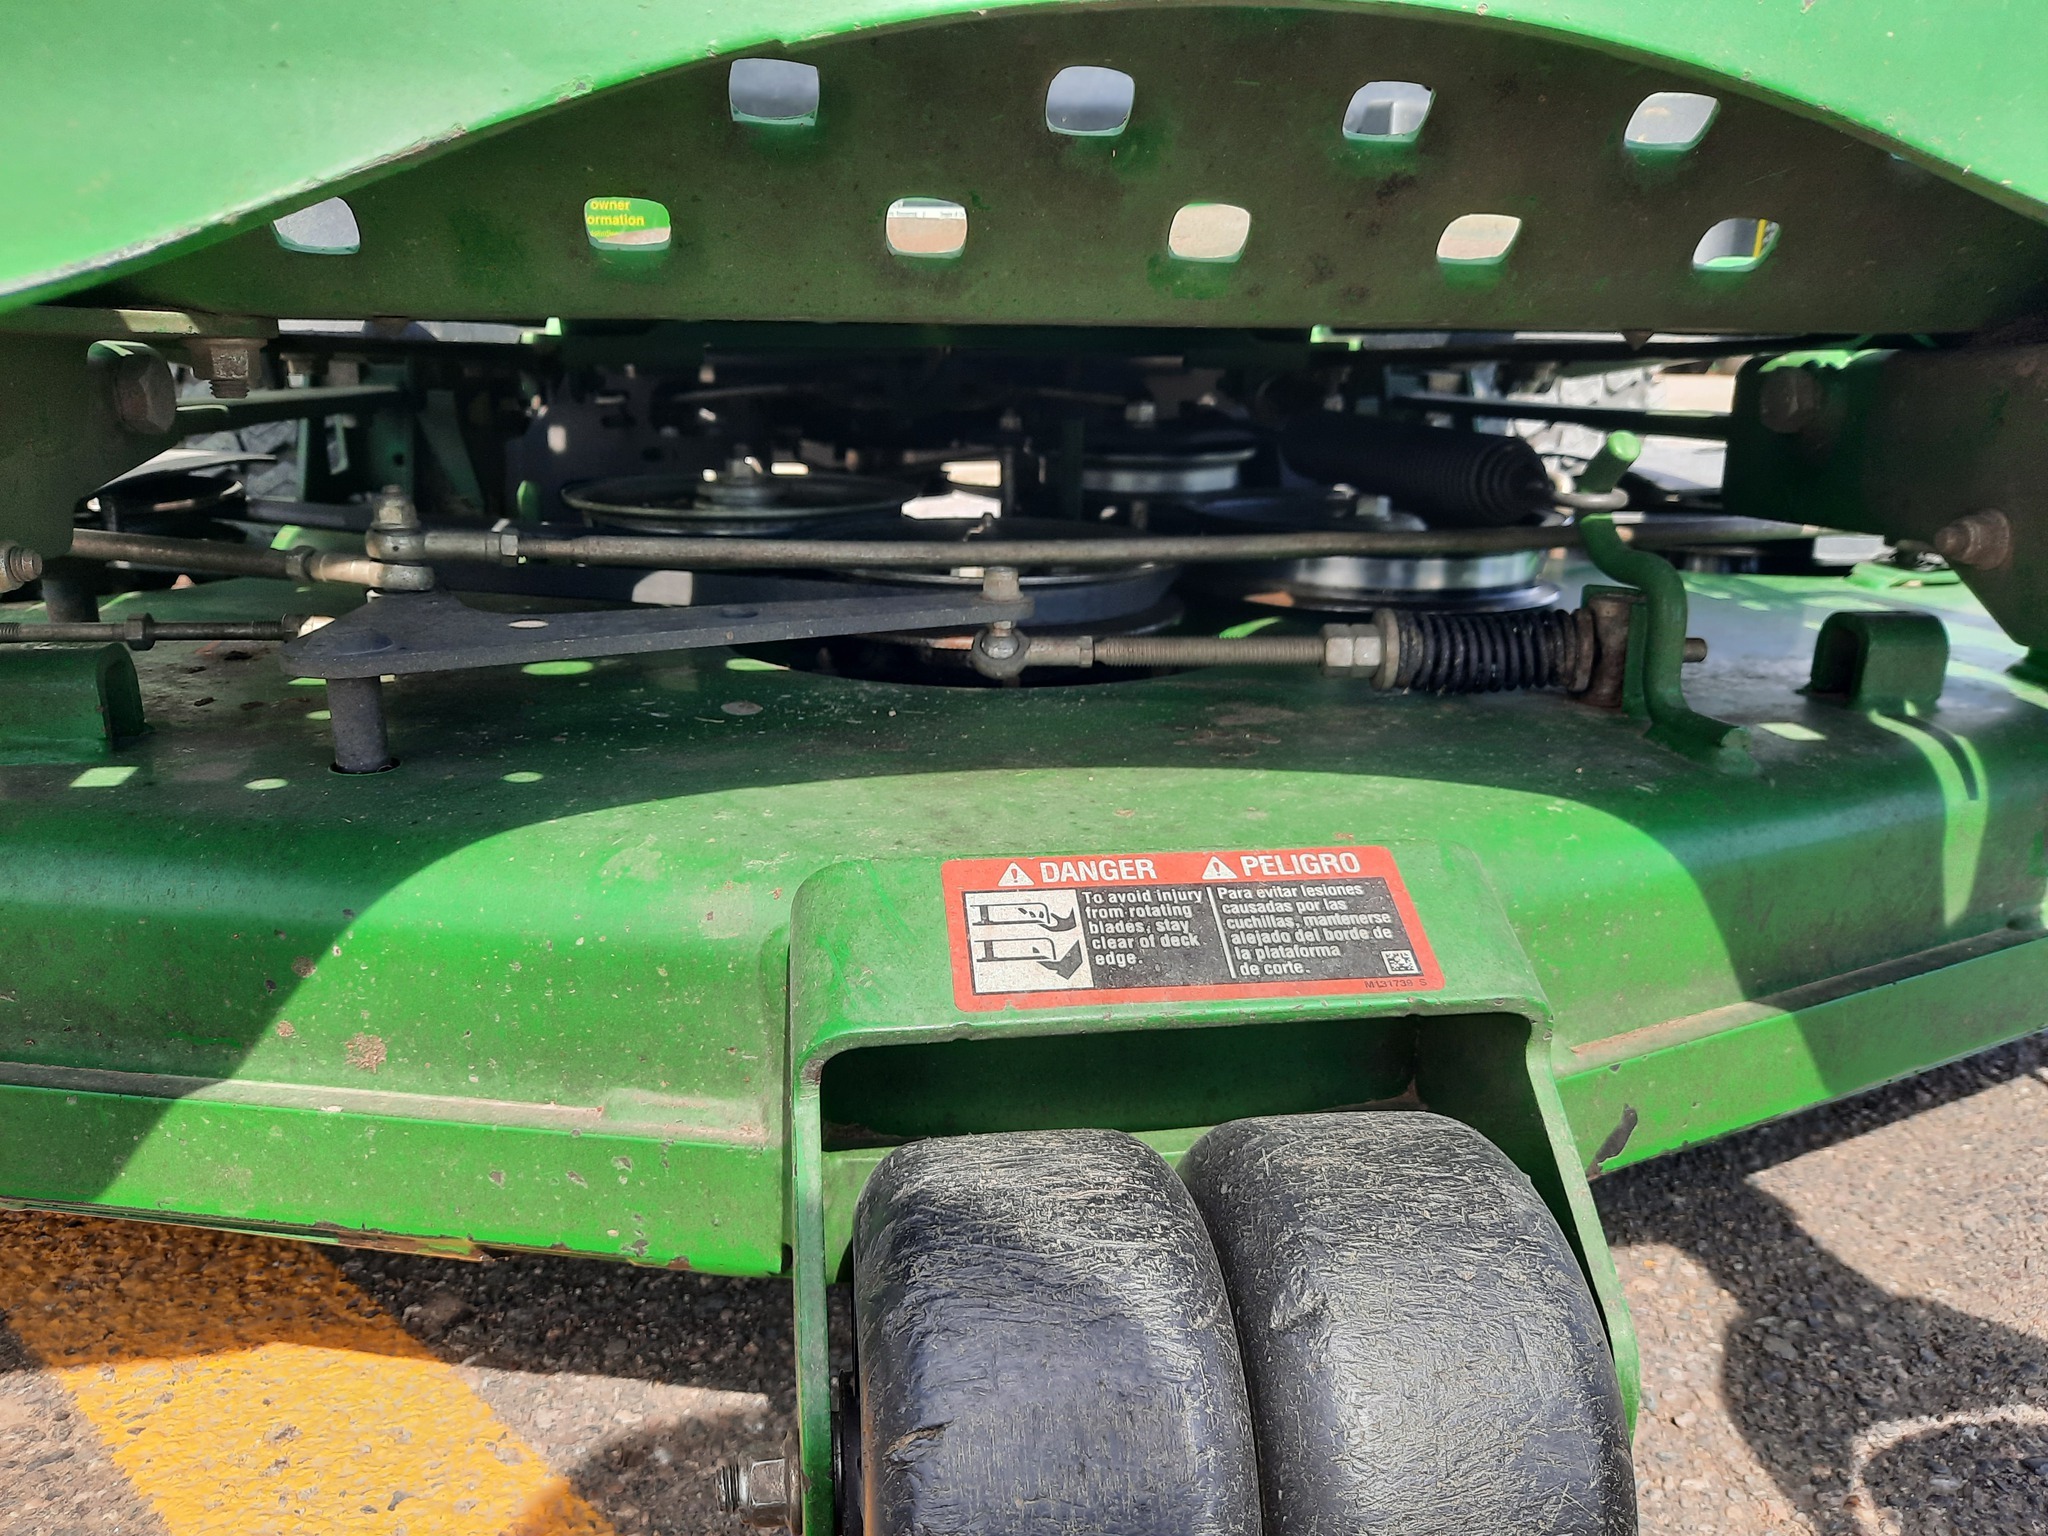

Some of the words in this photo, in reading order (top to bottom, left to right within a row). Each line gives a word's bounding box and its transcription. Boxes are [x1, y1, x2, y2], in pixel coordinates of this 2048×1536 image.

[591, 200, 630, 211] owner
[1039, 858, 1158, 883] DANGER
[1240, 852, 1361, 877] PELIGRO
[1082, 890, 1104, 904] To
[1108, 889, 1152, 904] avoid
[1156, 888, 1203, 906] injury
[1217, 887, 1252, 900] Para
[1256, 885, 1298, 899] evitar
[1301, 883, 1364, 897] lesiones
[1085, 905, 1124, 919] from
[1127, 903, 1193, 920] rotating
[1221, 899, 1294, 915] causadas
[1297, 900, 1321, 915] por
[1325, 897, 1348, 912] las
[1088, 920, 1151, 935] blades,
[1155, 919, 1190, 935] stay
[1226, 914, 1301, 930] cuchillas,
[1304, 911, 1392, 927] mantenerse
[1091, 935, 1133, 950] clear
[1139, 934, 1155, 949] of
[1160, 933, 1201, 947] deck
[1230, 931, 1291, 947] alejado
[1295, 928, 1321, 943] del
[1325, 926, 1369, 942] borde
[1372, 925, 1393, 940] de
[1095, 953, 1144, 969] edge.
[1235, 946, 1251, 961] la
[1254, 944, 1342, 962] plataforma
[1239, 962, 1260, 976] de
[1264, 961, 1312, 976] corte.
